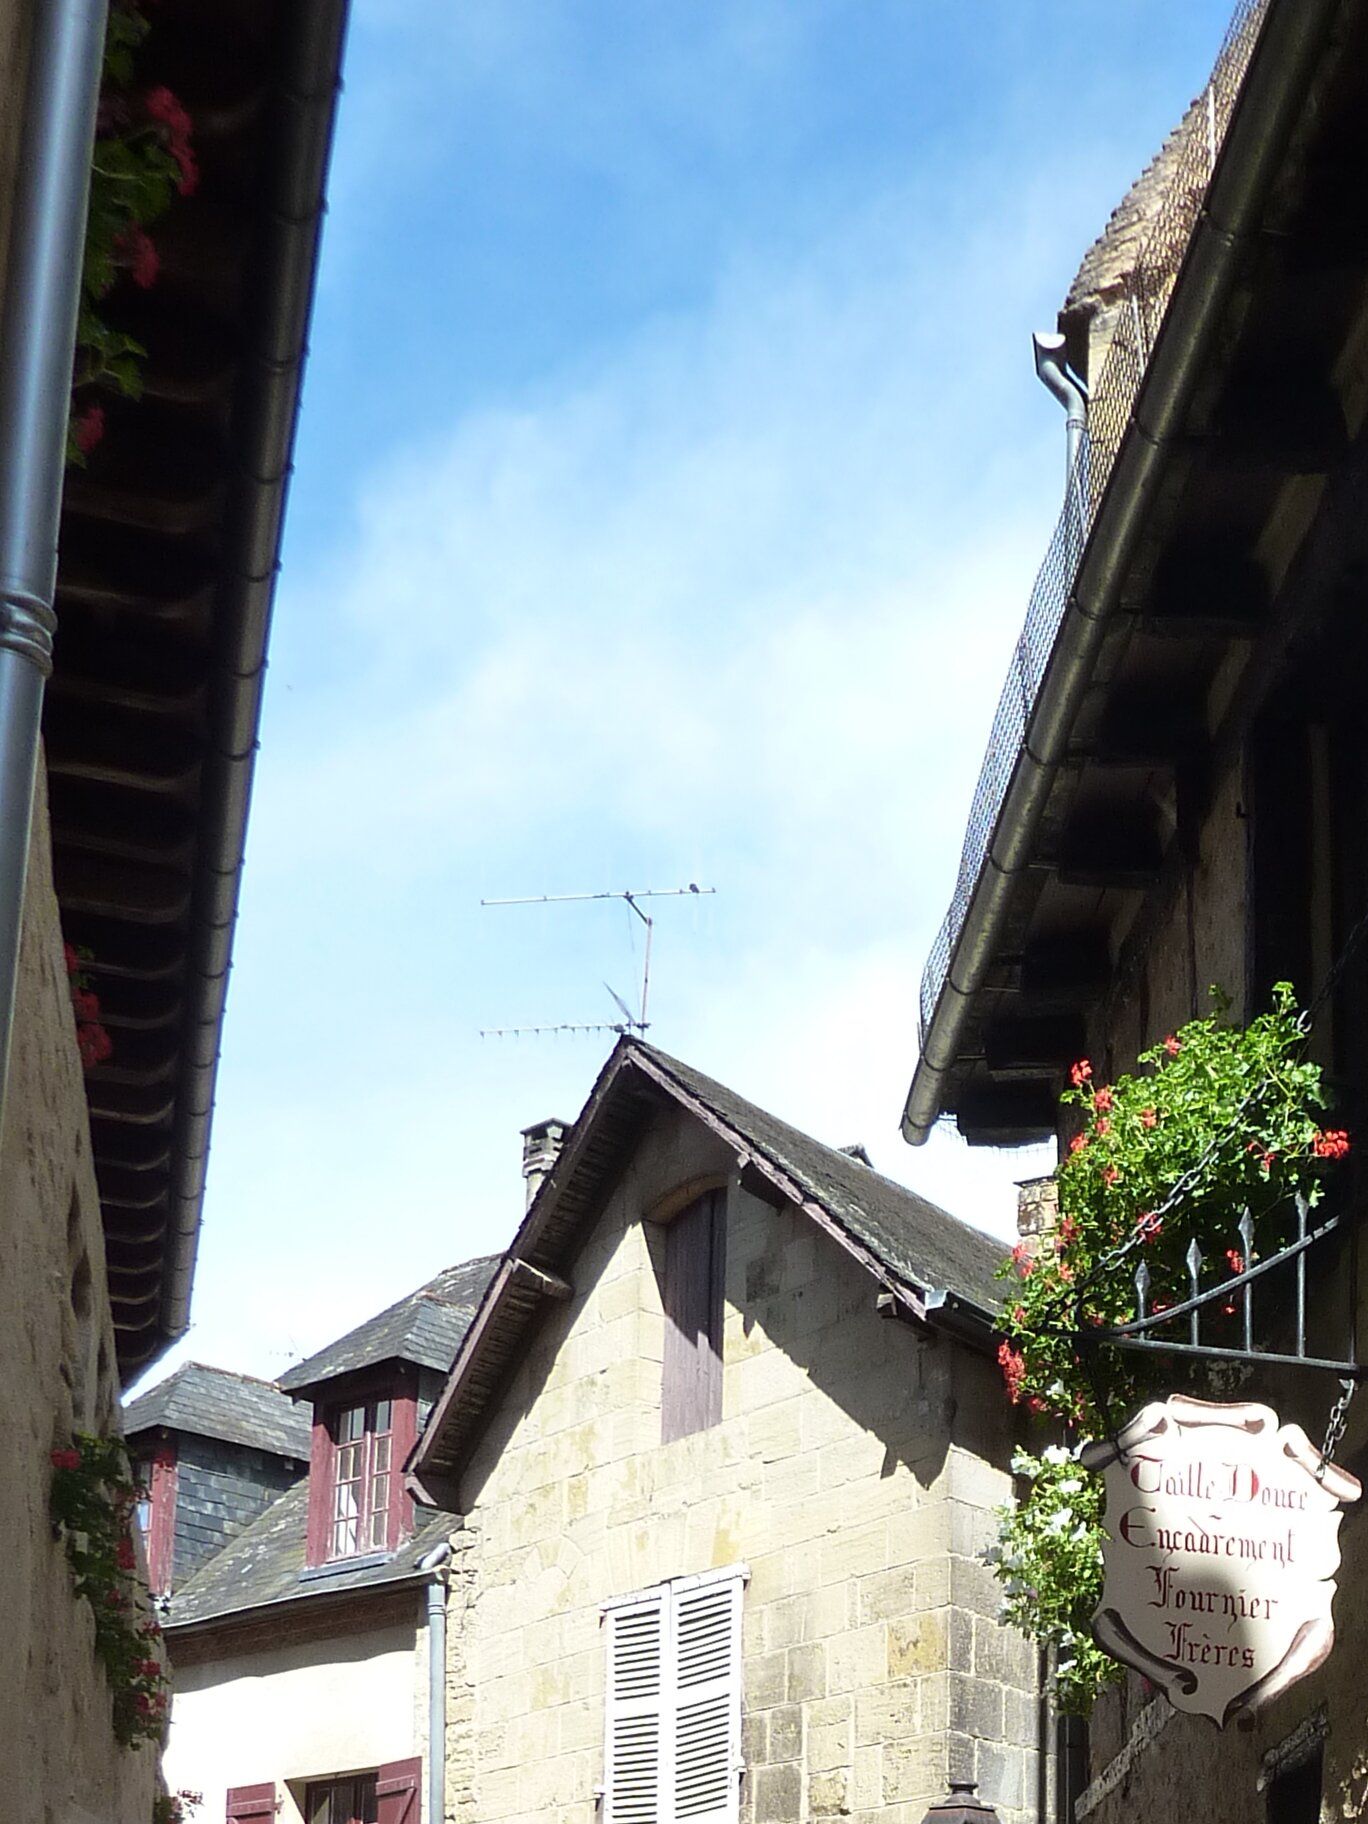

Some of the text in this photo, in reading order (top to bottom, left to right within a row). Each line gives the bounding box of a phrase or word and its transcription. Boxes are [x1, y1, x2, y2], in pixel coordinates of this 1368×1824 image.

[1130, 1453, 1309, 1511] Taille Douce
[1119, 1505, 1296, 1570] Encadrement
[1145, 1564, 1279, 1632] Fournier
[1162, 1620, 1257, 1669] Frères
